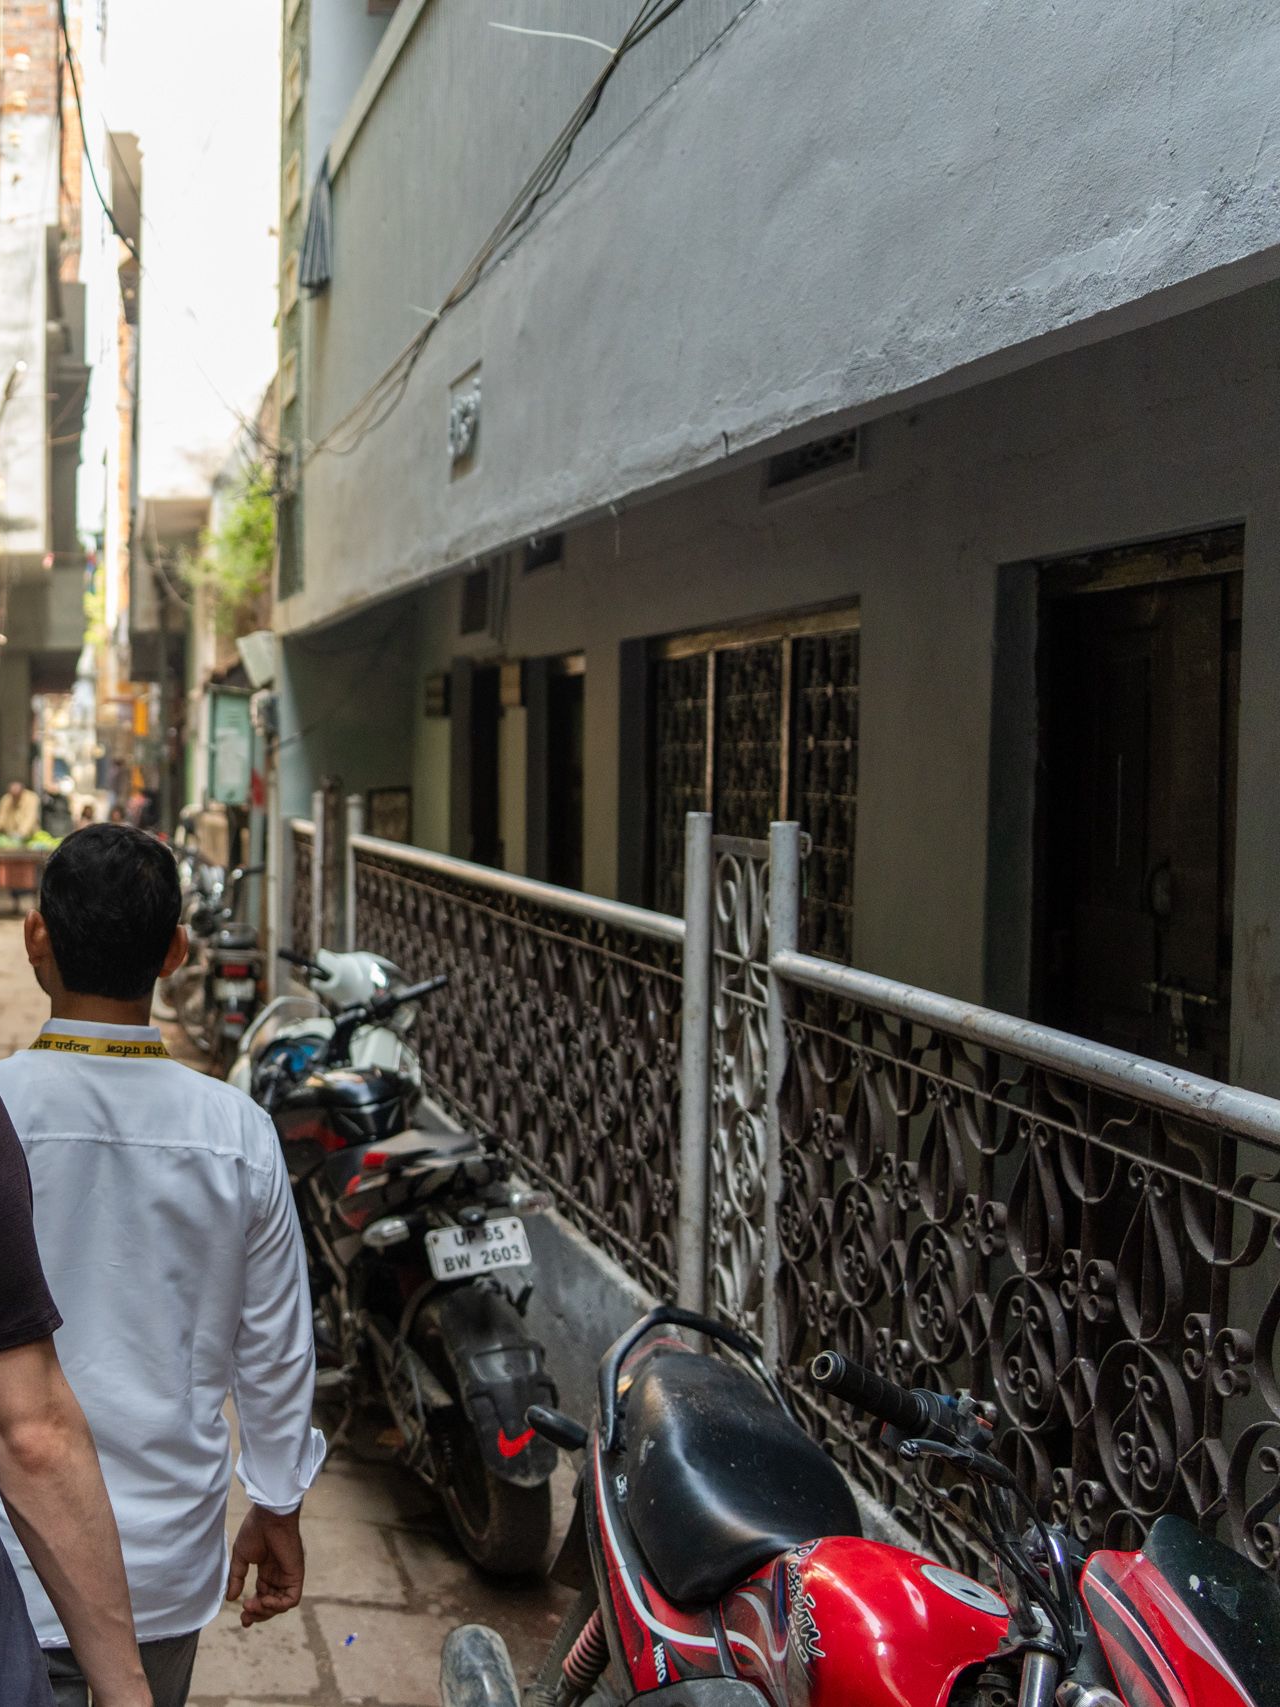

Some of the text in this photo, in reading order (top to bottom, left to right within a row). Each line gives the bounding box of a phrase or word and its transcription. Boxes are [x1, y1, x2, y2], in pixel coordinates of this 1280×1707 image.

[55, 1039, 92, 1052] पर्यटन
[105, 1043, 141, 1057] पर्यटन
[454, 1225, 505, 1247] UP 65
[443, 1244, 522, 1273] BW 2603
[786, 1538, 826, 1659] Passion
[652, 1641, 667, 1683] Hero
